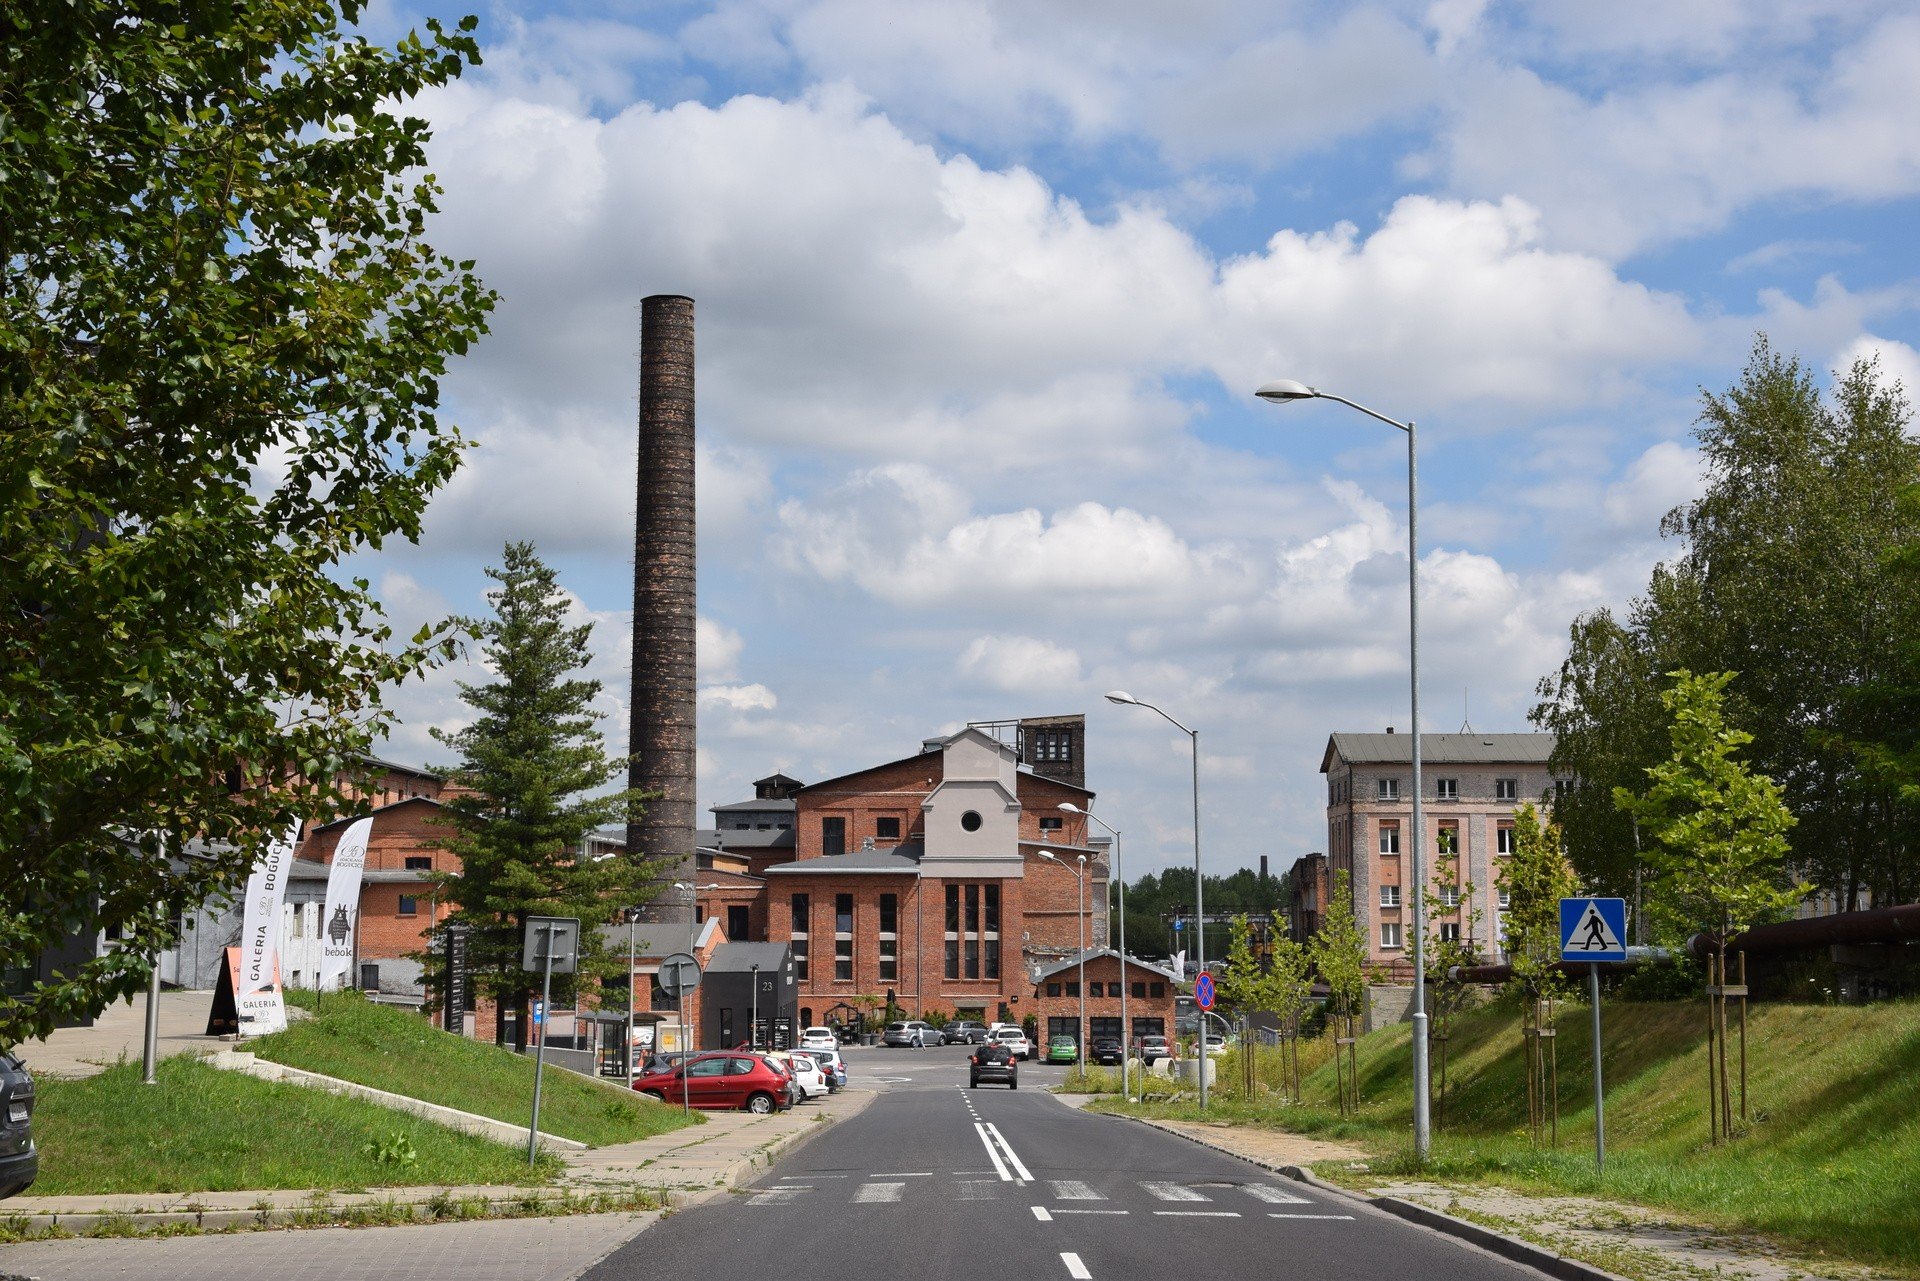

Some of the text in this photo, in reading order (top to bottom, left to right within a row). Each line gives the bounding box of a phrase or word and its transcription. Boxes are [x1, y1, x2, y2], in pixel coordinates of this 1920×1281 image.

[250, 926, 267, 981] GALERIA
[325, 947, 352, 957] bebok
[762, 981, 773, 991] 23
[243, 1000, 277, 1009] GALERIA
